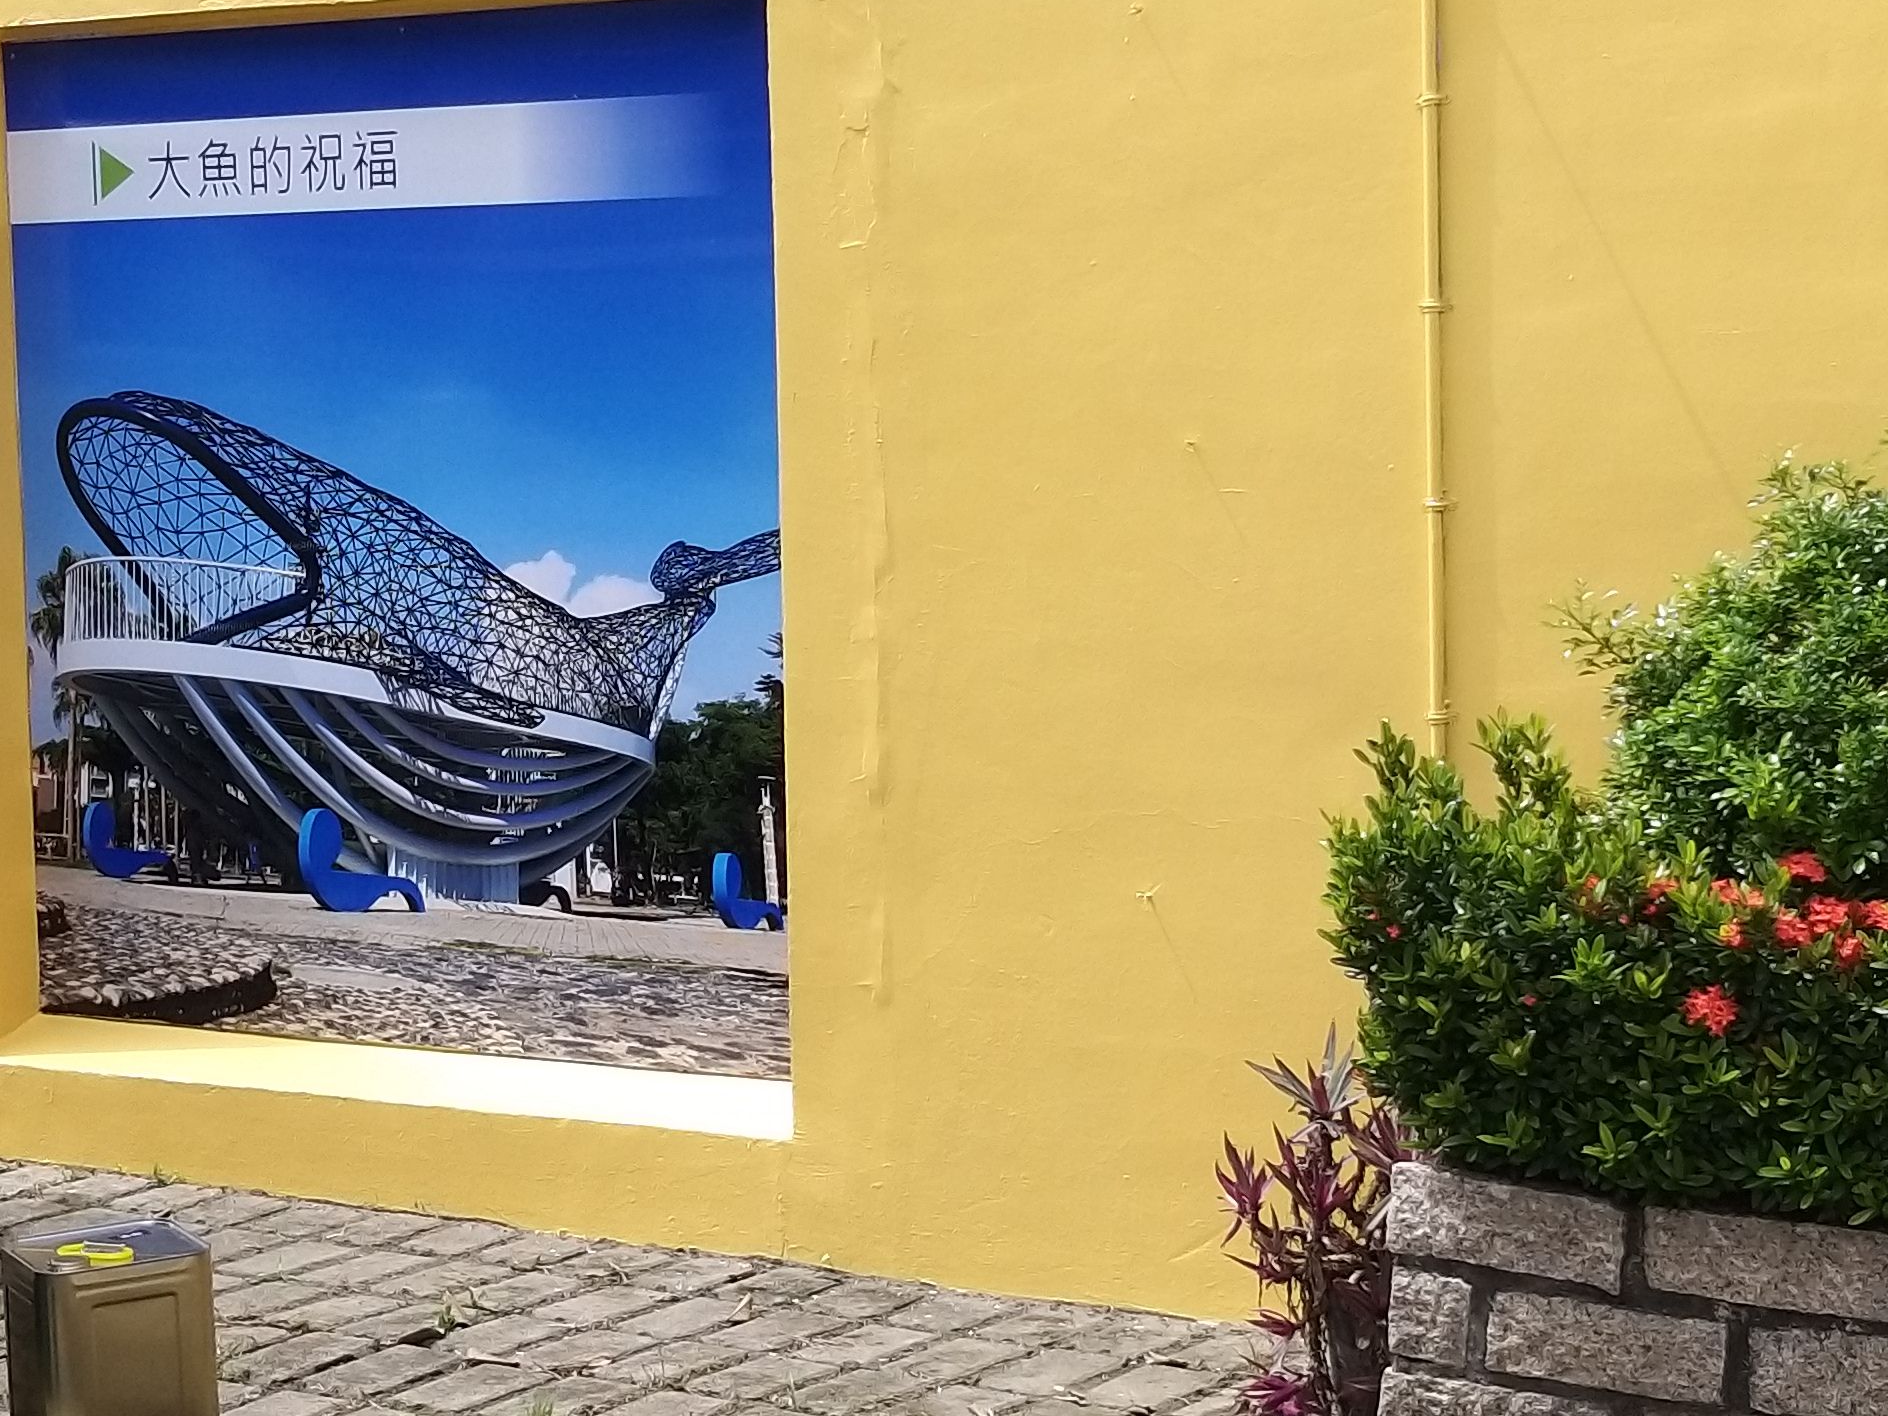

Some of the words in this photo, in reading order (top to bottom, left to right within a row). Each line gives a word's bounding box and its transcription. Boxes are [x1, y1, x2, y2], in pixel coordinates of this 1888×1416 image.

[147, 129, 399, 201] 大魚的祝福
